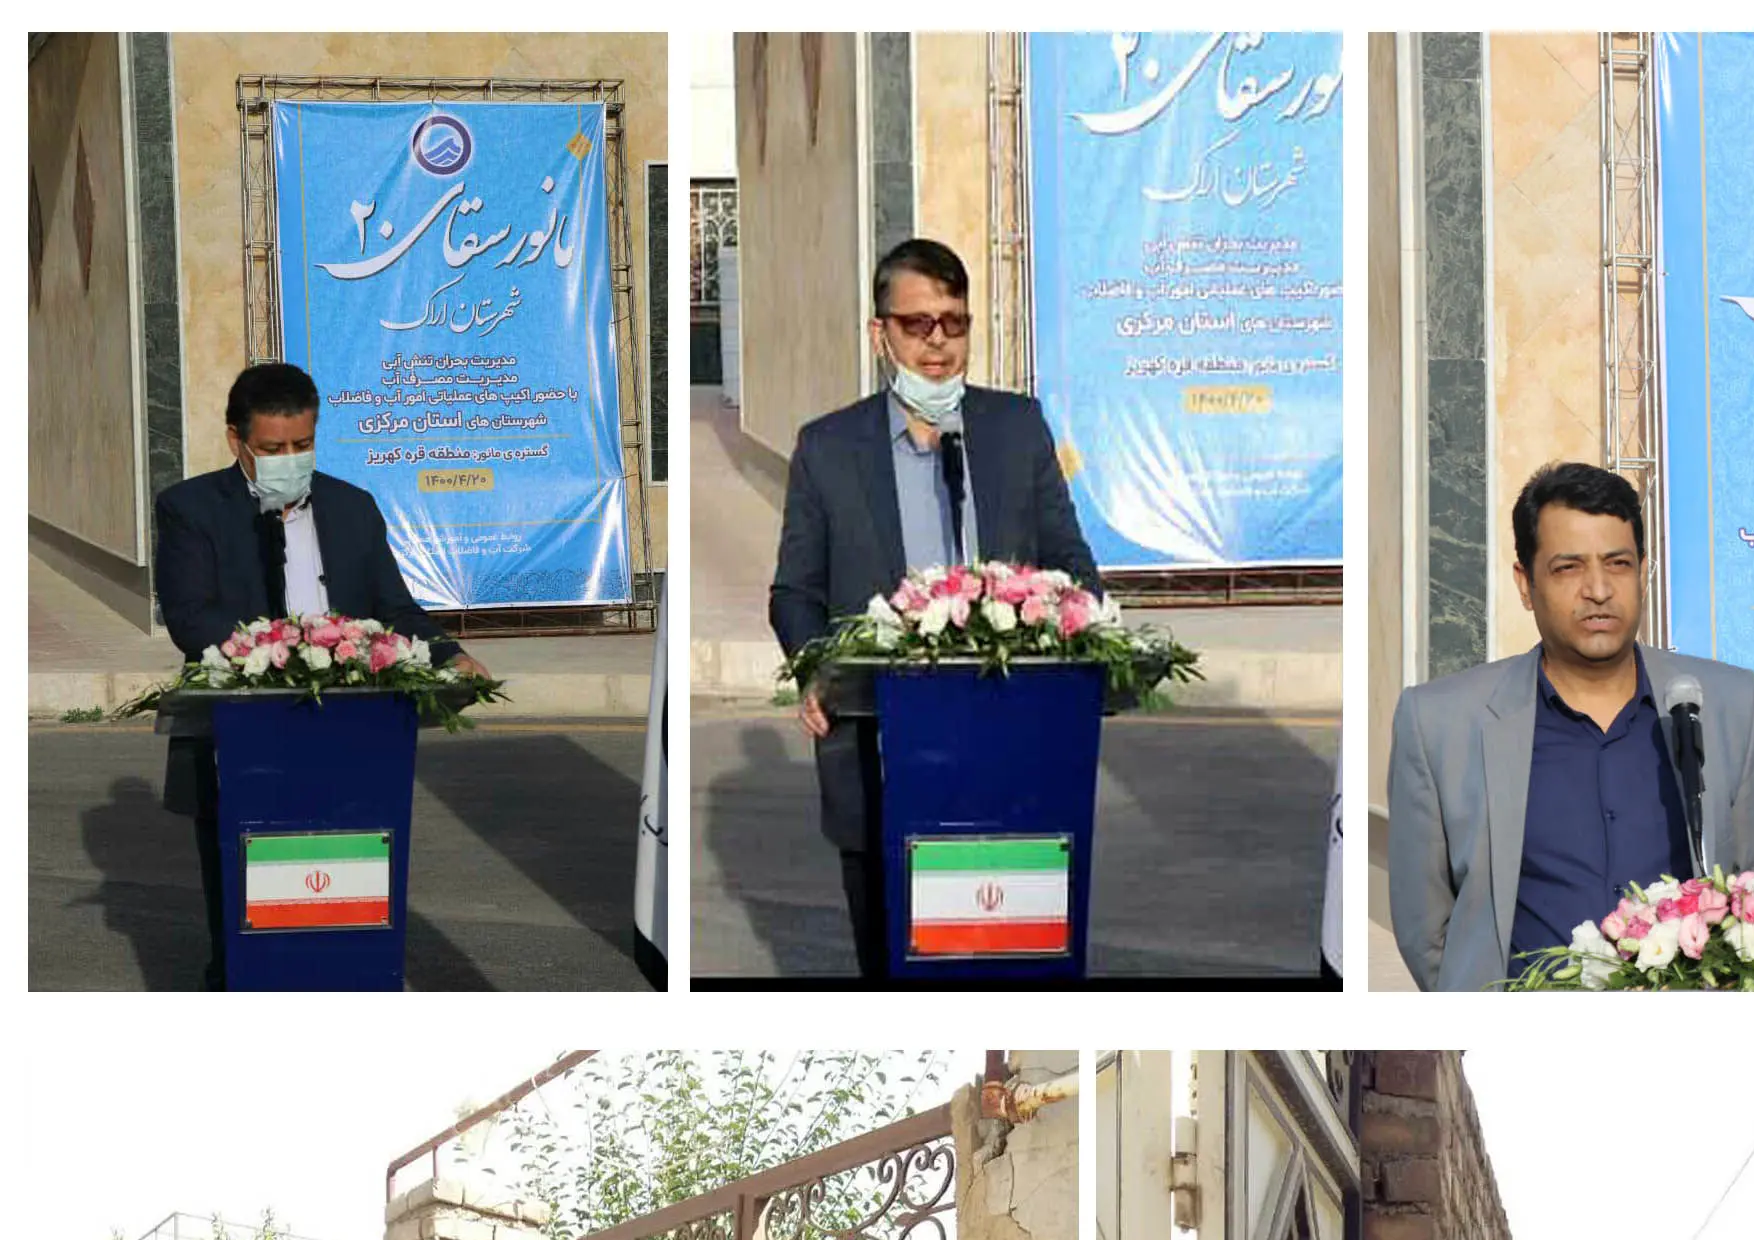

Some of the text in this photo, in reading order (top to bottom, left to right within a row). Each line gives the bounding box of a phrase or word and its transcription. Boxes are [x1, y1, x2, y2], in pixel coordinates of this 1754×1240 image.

[1142, 125, 1308, 209] شهرستان اراک
[314, 176, 574, 280] مانور سقای ۲۰
[380, 272, 523, 337] شهرستان اراک
[382, 354, 517, 370] مدیریت بحران تنش آبی
[382, 372, 518, 386] مدیریت مصرف آب
[328, 387, 578, 407] با حضور اکیپ های عملیاتی امور آب و فاضلاب
[358, 411, 547, 434] شهرستان های استان مرکزی
[366, 443, 549, 465] گستره ی مانور: منطقه قره کهریز
[425, 474, 487, 488] ۱۴۰۰/۴/۲۰
